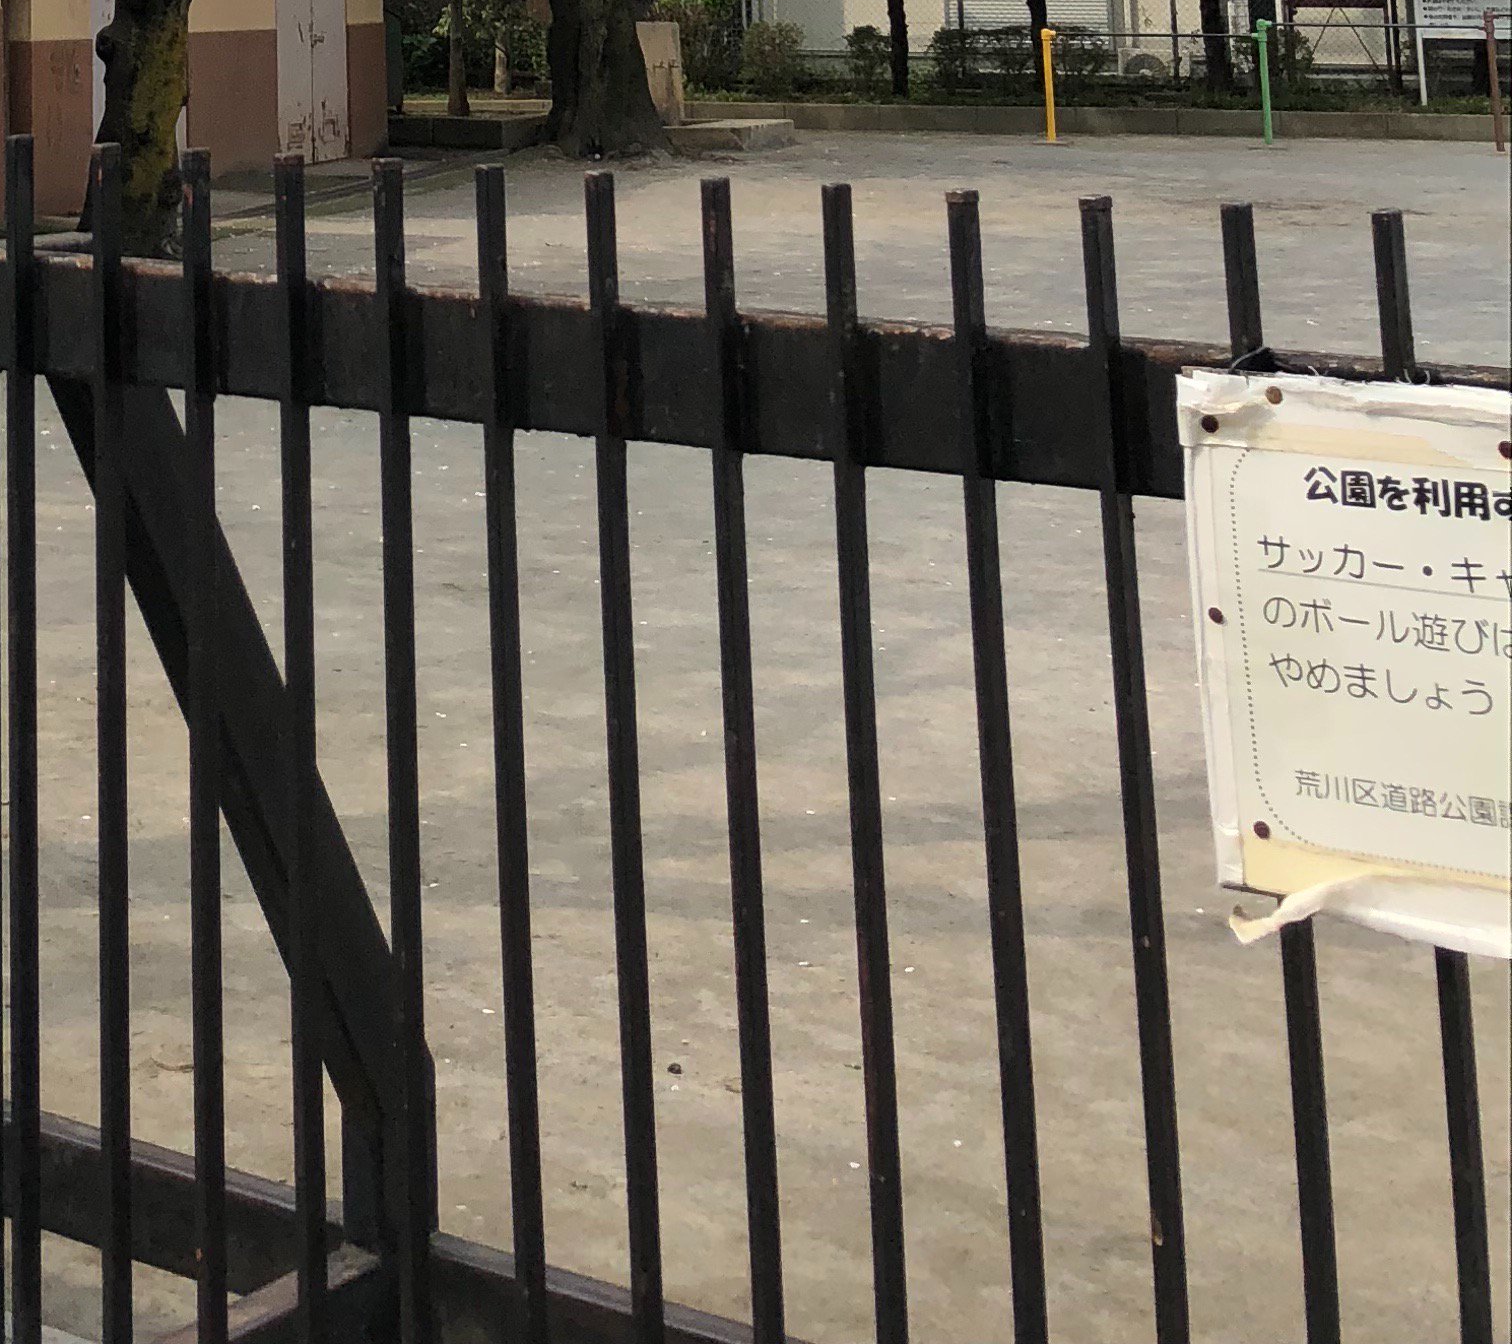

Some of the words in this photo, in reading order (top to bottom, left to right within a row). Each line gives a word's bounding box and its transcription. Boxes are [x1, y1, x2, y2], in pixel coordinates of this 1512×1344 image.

[1304, 466, 1512, 520] 公園を利用す
[1269, 653, 1493, 716] やめましょう
